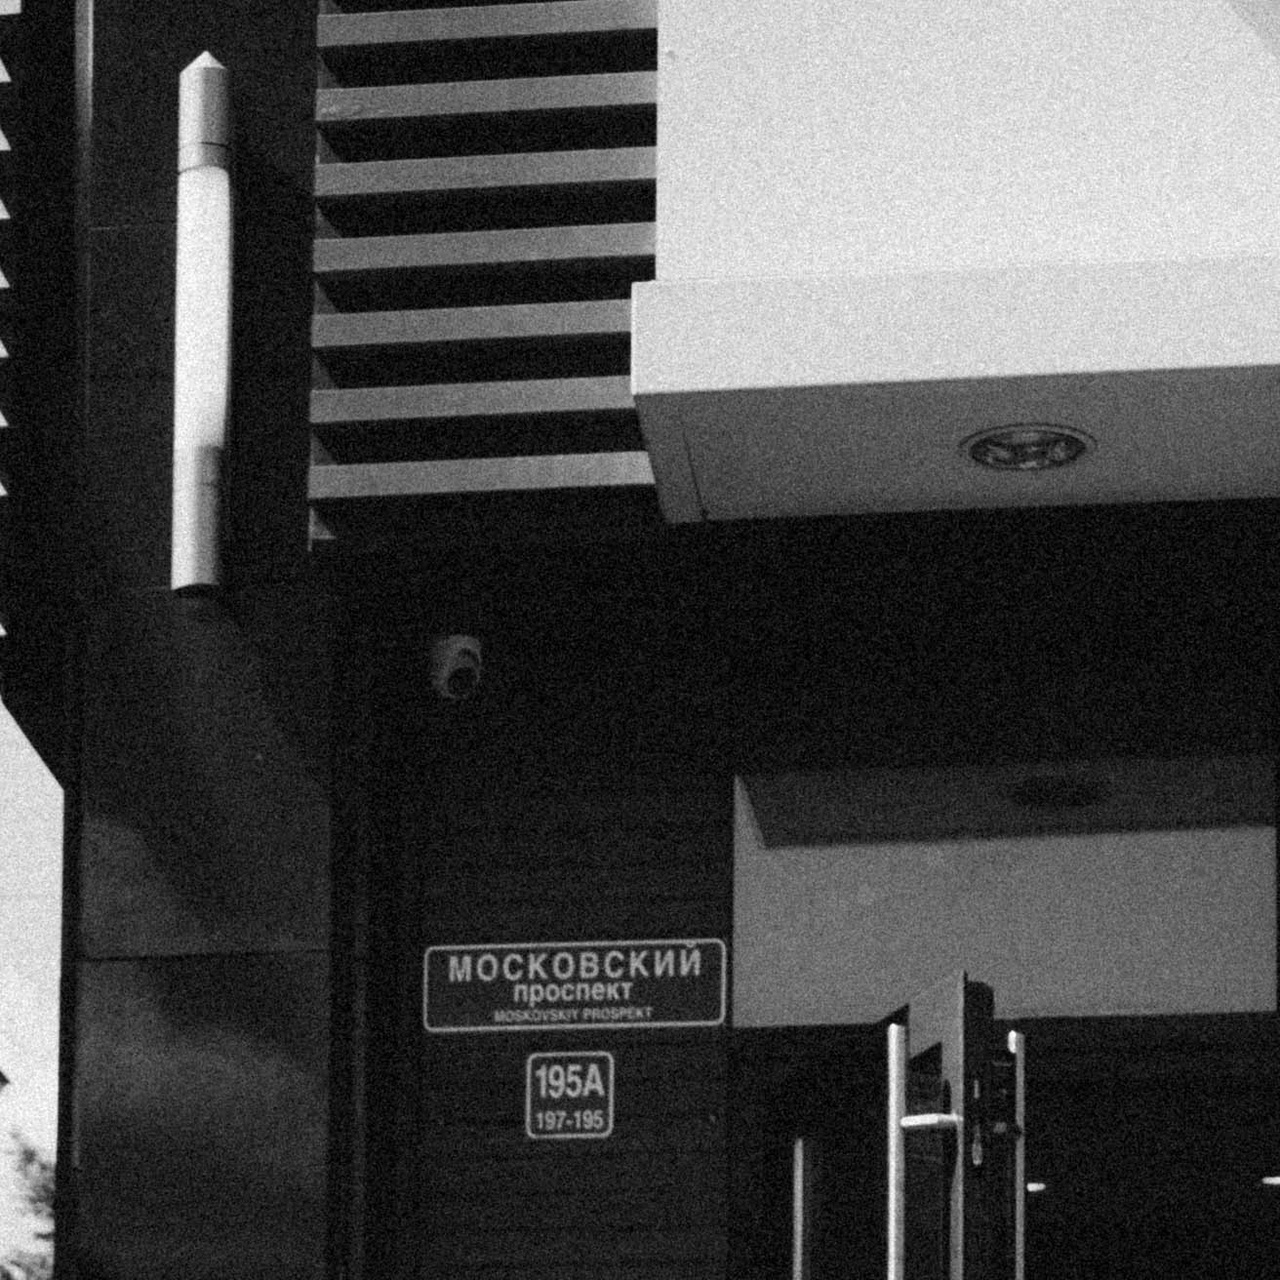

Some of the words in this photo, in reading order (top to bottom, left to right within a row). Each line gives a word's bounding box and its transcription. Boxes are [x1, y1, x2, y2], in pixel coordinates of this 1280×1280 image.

[448, 944, 701, 982] МОСКОВСКИЙ
[513, 981, 633, 1006] проспект
[583, 1006, 653, 1020] PROSPEKT
[536, 1109, 604, 1130] 197-195
